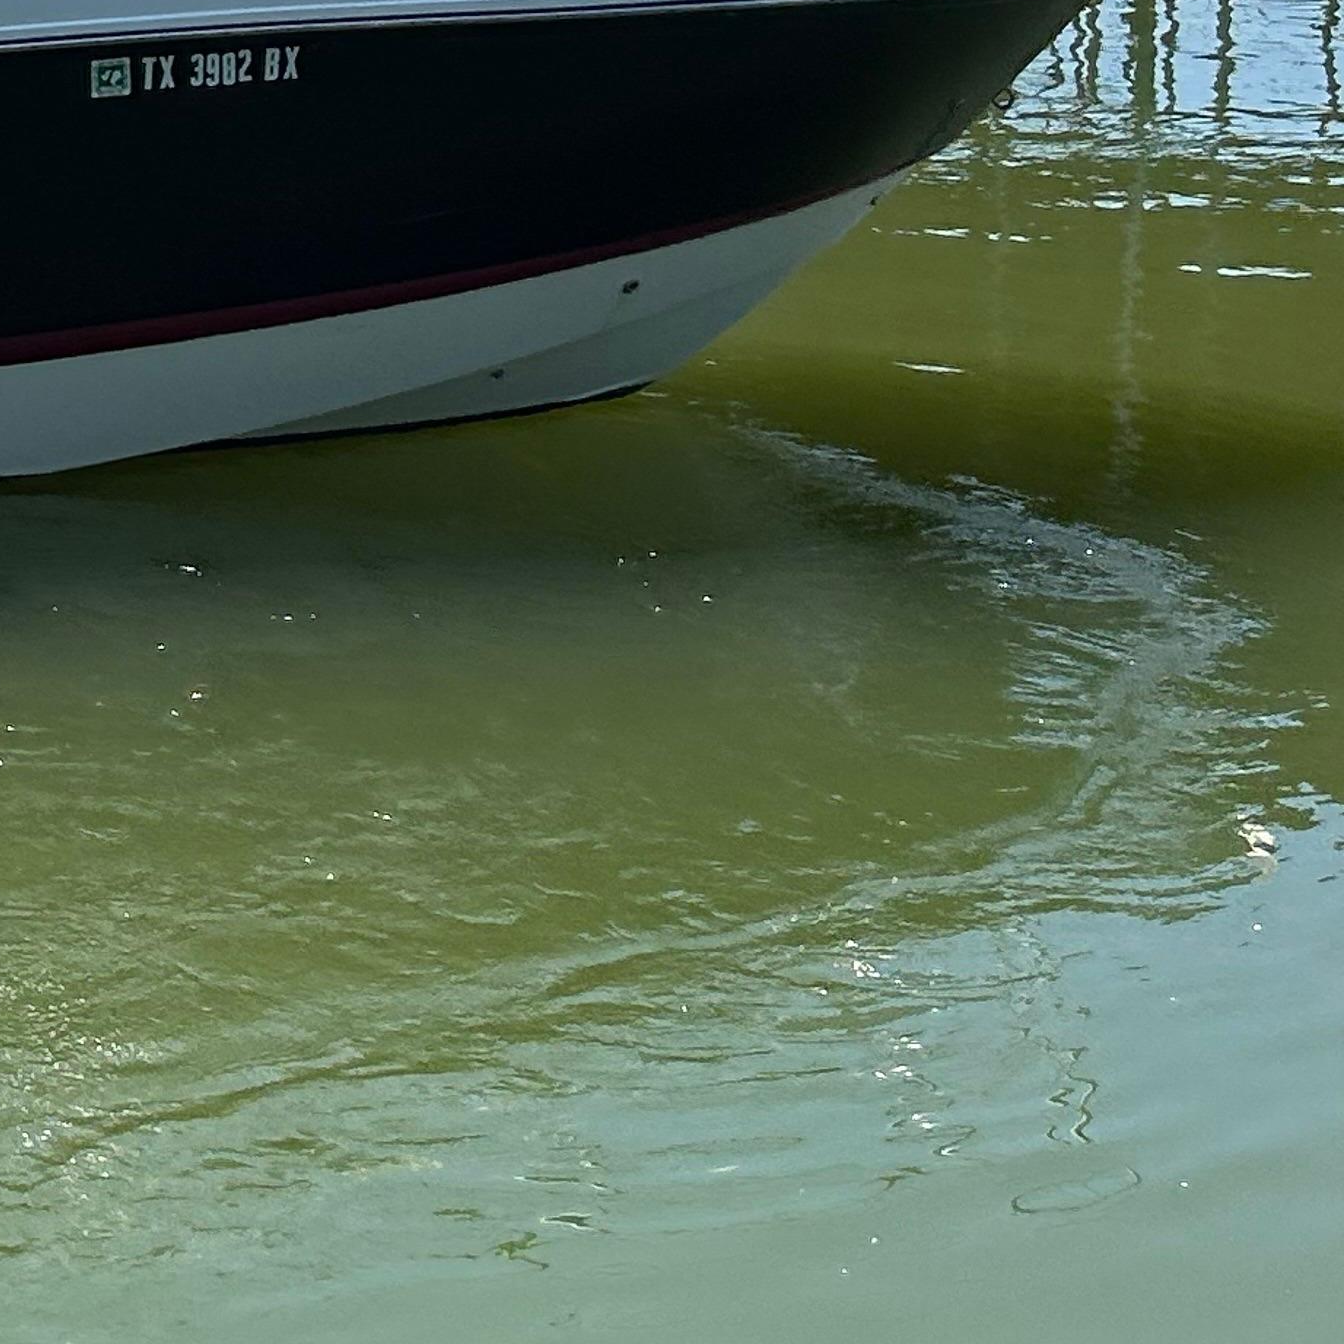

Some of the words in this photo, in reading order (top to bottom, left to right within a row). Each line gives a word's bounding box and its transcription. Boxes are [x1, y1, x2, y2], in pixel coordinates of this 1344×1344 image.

[141, 55, 176, 90] TX
[189, 49, 253, 87] 3902
[263, 45, 301, 82] BX
